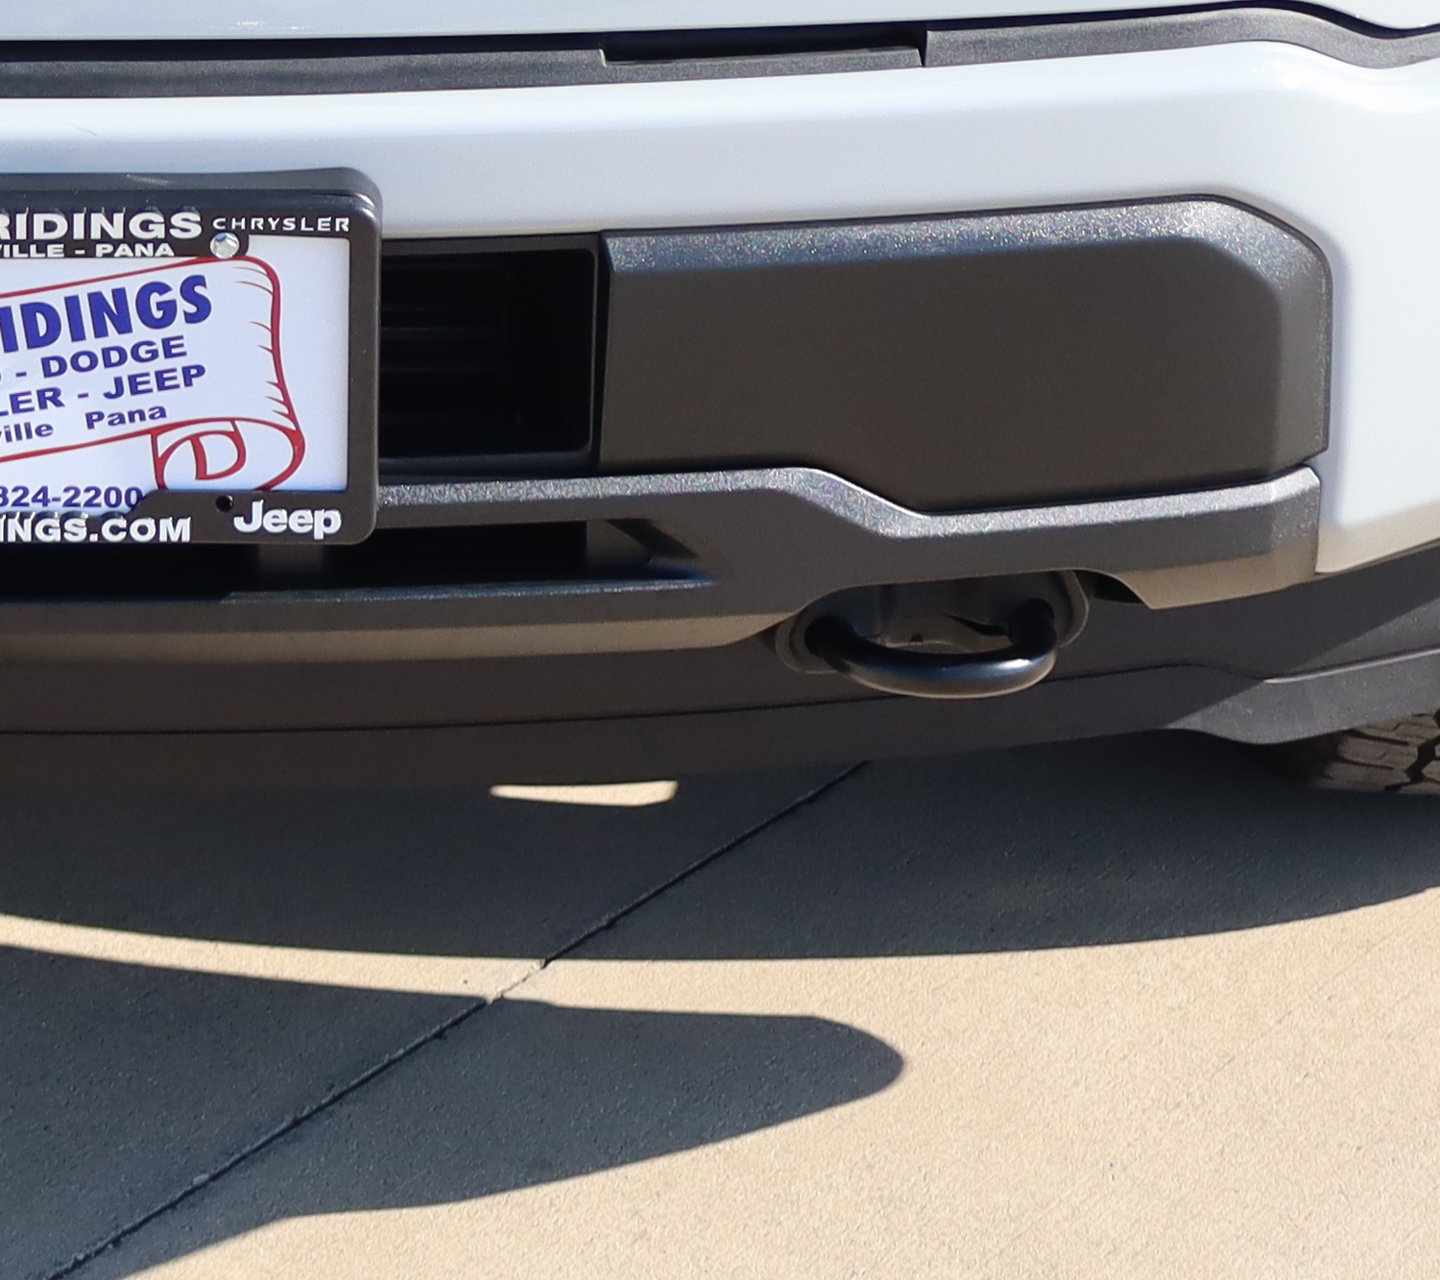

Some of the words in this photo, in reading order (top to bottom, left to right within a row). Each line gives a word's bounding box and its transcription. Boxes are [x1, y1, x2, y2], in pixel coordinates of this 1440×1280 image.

[212, 217, 350, 232] CHRYSLER
[95, 243, 175, 258] PANA
[40, 335, 188, 379] DODGE
[102, 364, 207, 400] JEEP
[85, 406, 167, 430] Pana
[233, 499, 342, 540] Jeep
